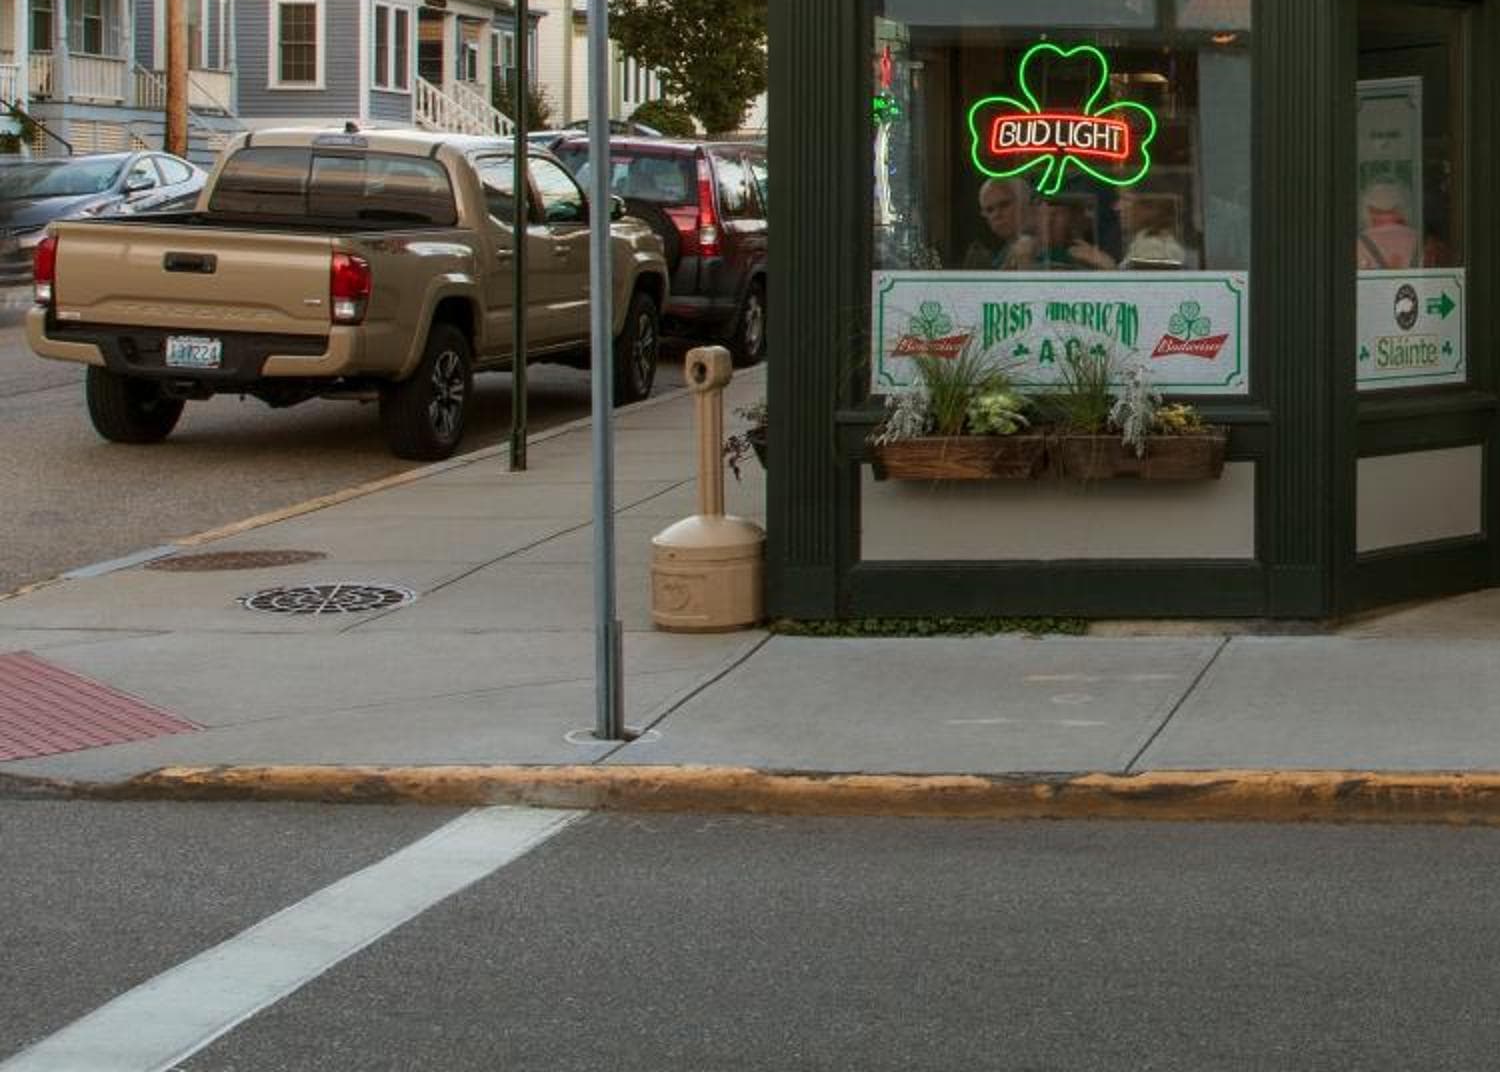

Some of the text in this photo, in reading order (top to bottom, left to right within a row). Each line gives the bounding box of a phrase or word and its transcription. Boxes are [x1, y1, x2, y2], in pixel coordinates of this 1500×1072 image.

[1000, 120, 1123, 151] BUD LIGHT
[1039, 339, 1056, 363] A
[1159, 337, 1220, 354] Budweiser
